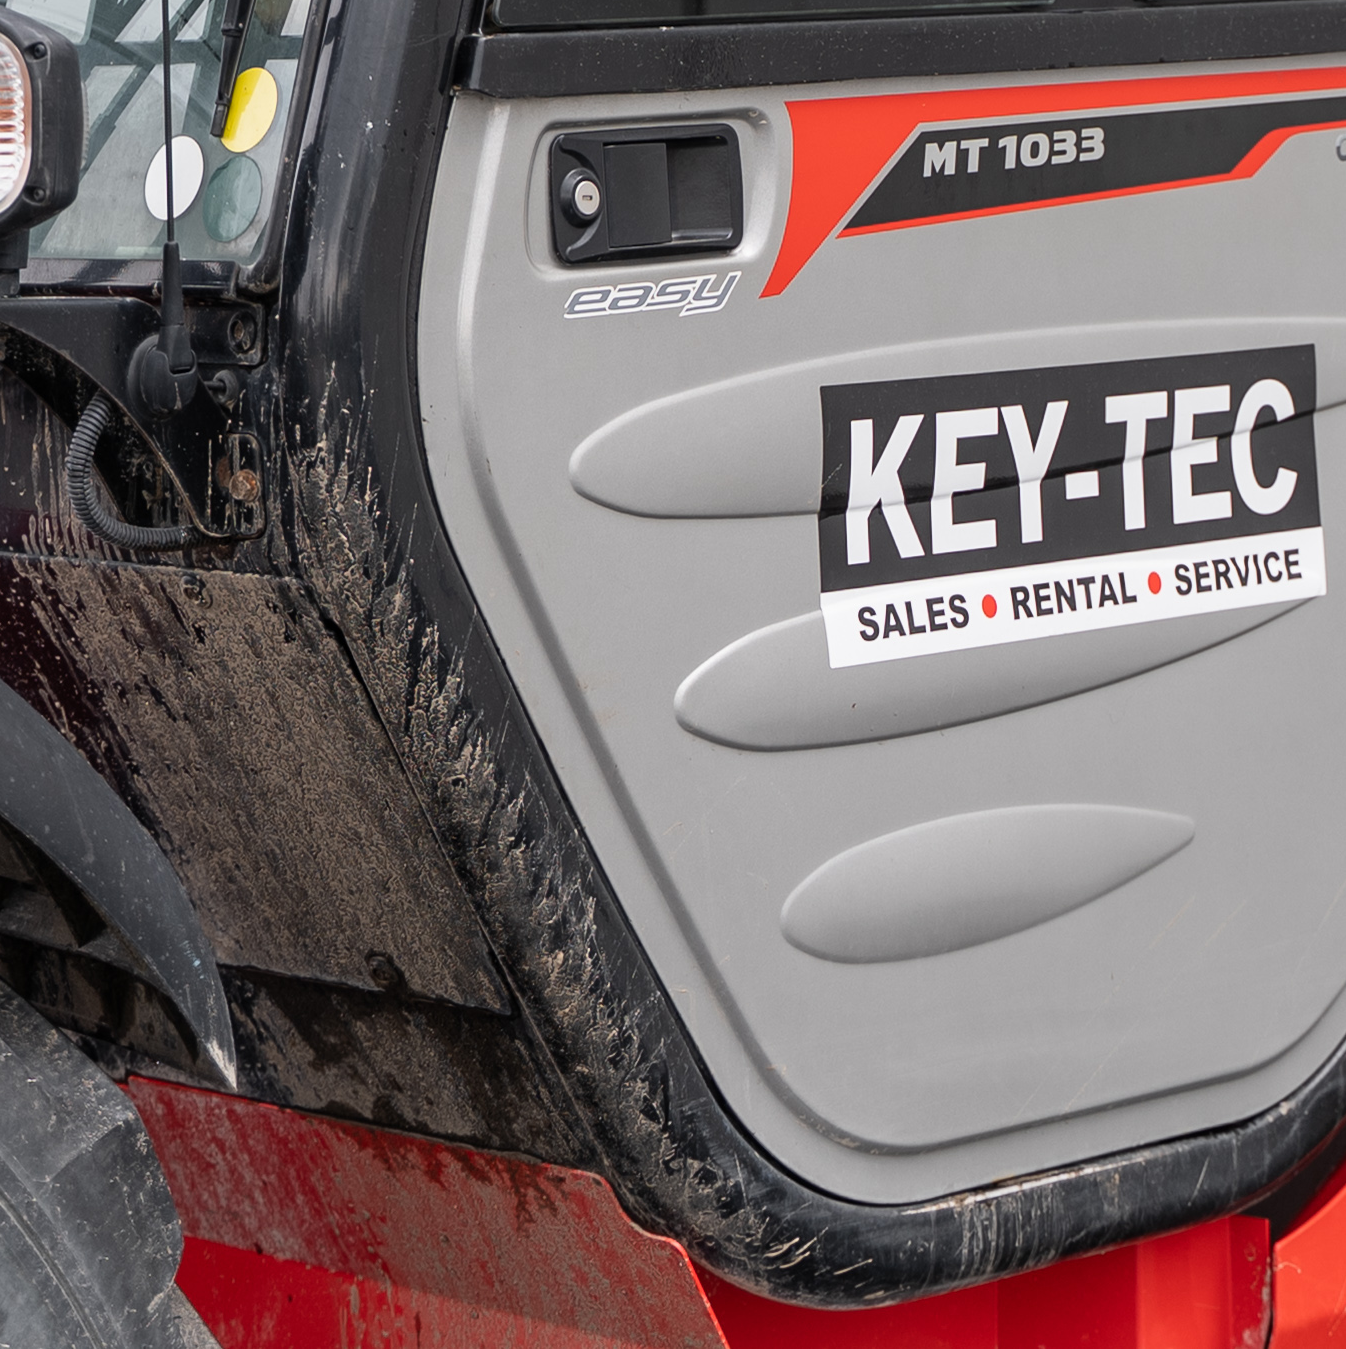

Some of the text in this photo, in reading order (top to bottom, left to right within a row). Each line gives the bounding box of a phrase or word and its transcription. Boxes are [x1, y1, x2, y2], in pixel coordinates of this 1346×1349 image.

[923, 127, 1105, 178] MT 1033
[564, 271, 742, 318] easy
[846, 378, 1299, 566] KEY-TEC
[857, 549, 1302, 642] SALES RENTAL SERVICE
